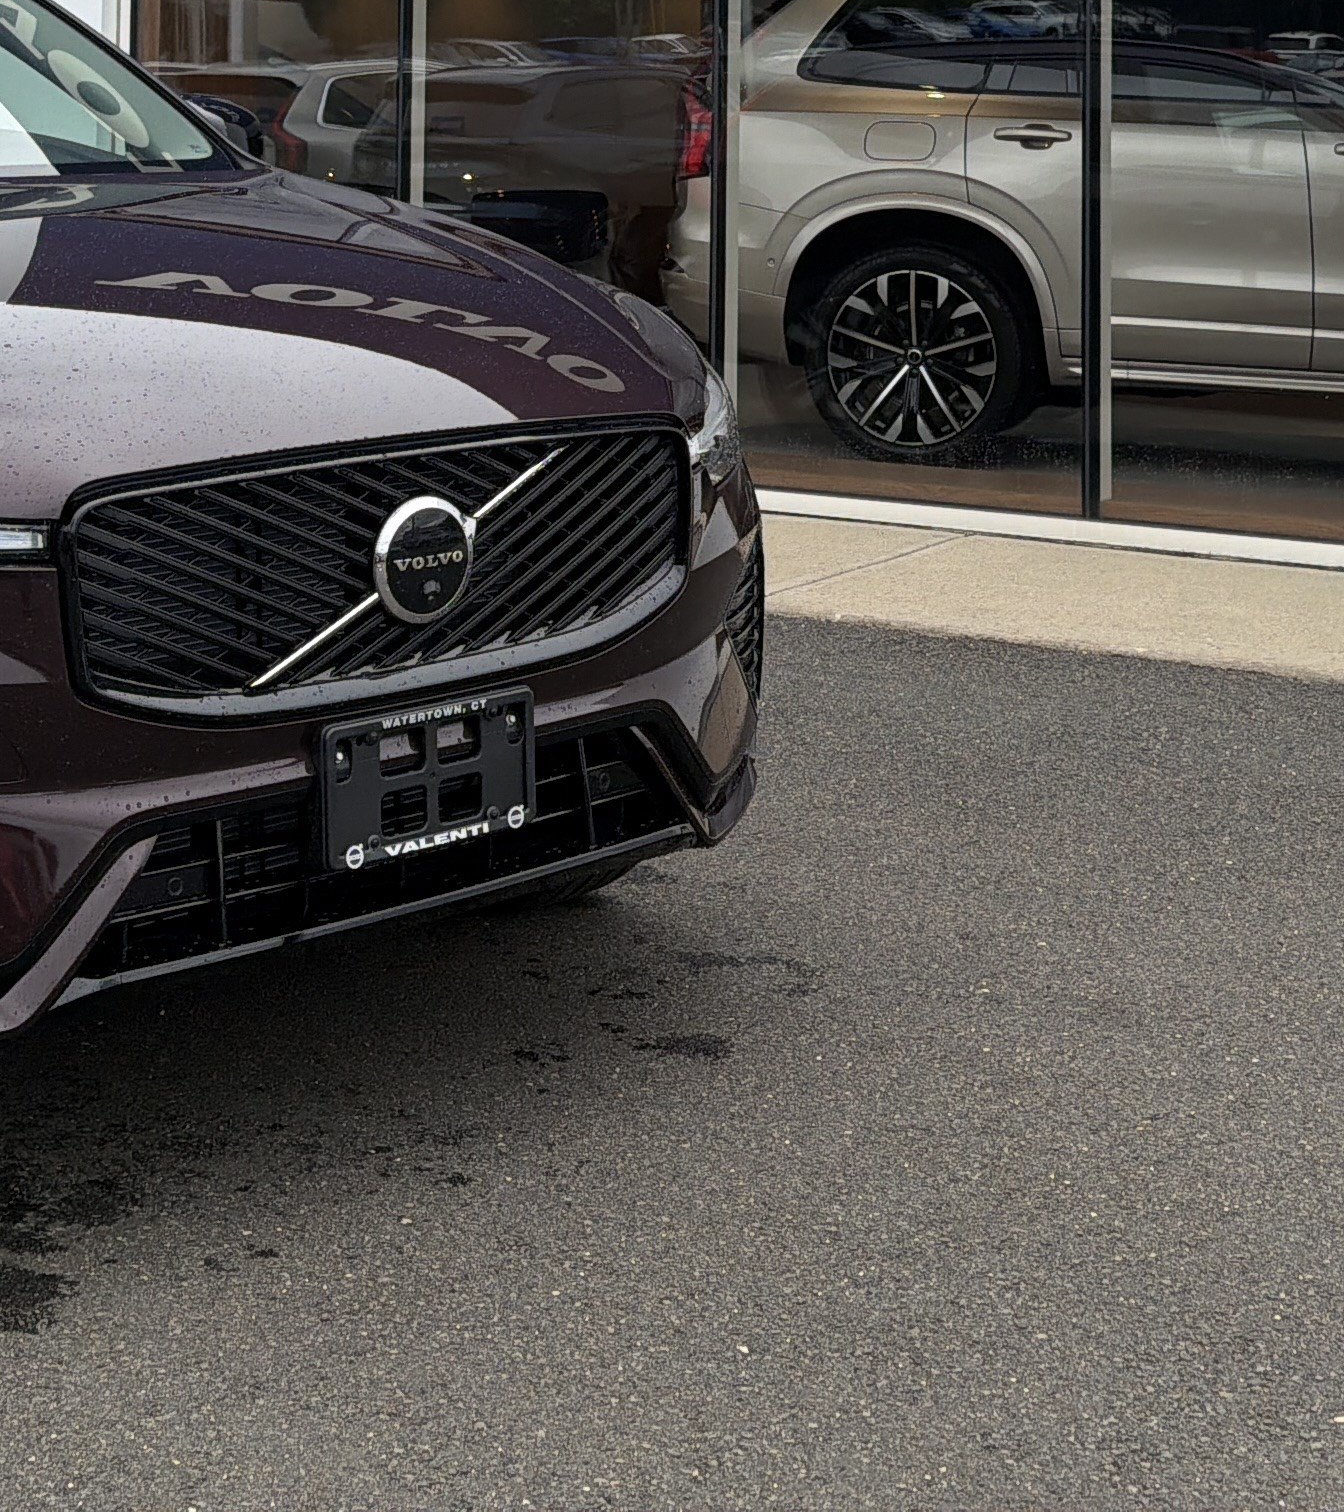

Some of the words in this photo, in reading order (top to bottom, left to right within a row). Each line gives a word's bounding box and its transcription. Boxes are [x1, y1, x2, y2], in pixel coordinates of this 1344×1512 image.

[393, 549, 464, 572] VOLVO
[471, 698, 488, 711] CT
[384, 821, 490, 857] VALENTI
